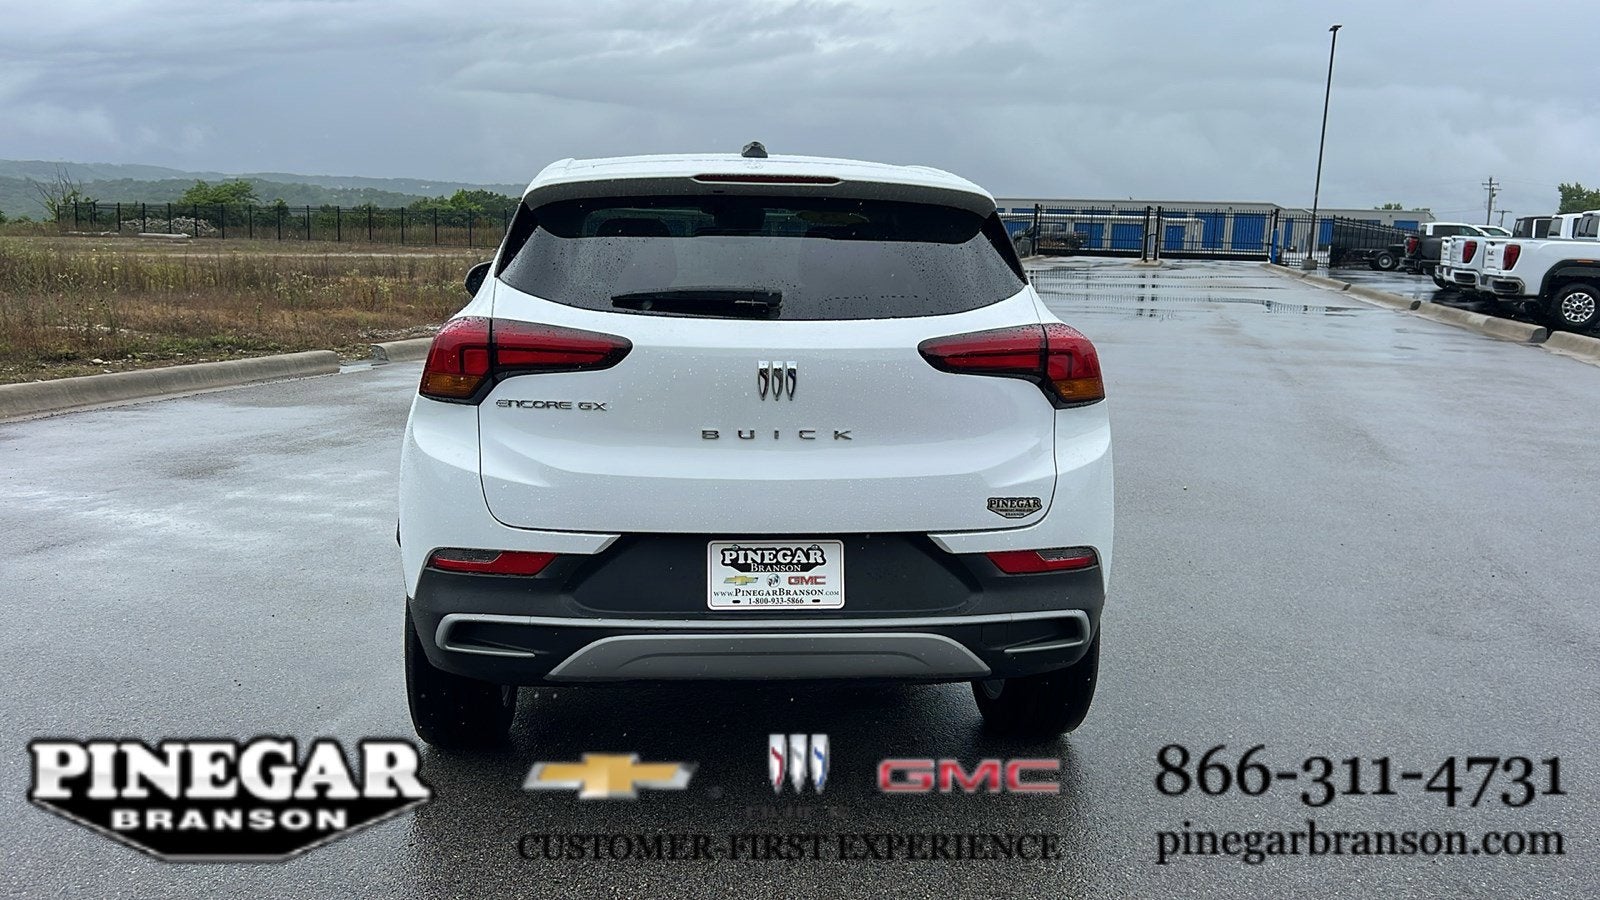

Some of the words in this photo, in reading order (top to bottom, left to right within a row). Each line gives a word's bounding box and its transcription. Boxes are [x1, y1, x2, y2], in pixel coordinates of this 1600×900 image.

[496, 399, 572, 410] ENCORE
[578, 401, 607, 411] GX
[702, 429, 853, 441] BUICK
[989, 499, 1040, 508] PINEGAR
[722, 549, 824, 564] PINEGAR
[788, 575, 826, 585] GMC
[748, 597, 804, 605] 1-800-933-5866
